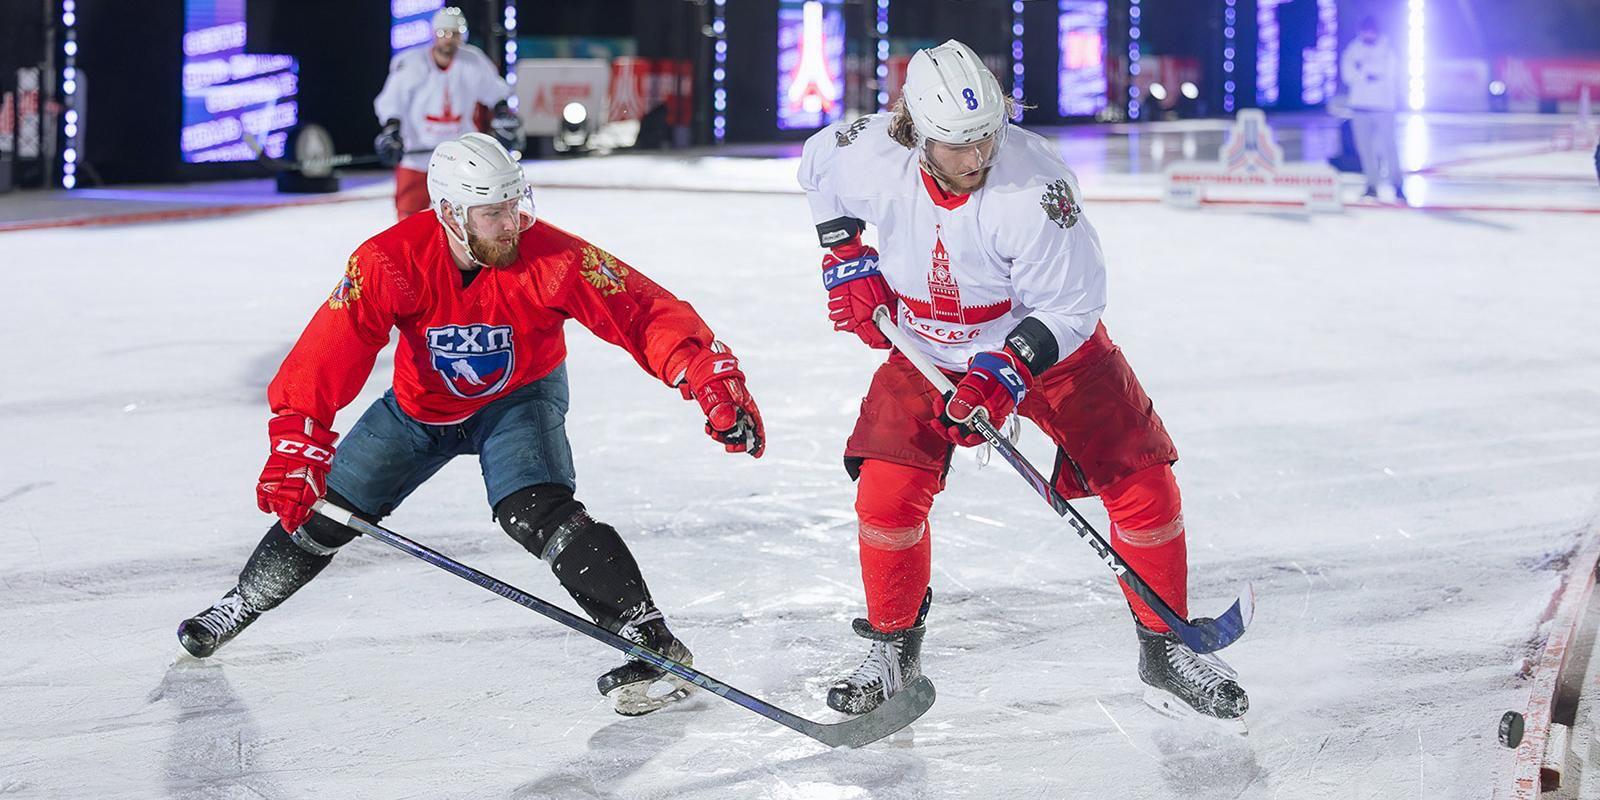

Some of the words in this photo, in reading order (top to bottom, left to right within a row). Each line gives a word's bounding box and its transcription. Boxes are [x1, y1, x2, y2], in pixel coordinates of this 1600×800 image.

[962, 88, 978, 110] 8
[824, 259, 880, 285] CCM
[429, 327, 511, 352] СХЛ
[1062, 508, 1126, 576] CCM
[490, 582, 538, 607] GHOST
